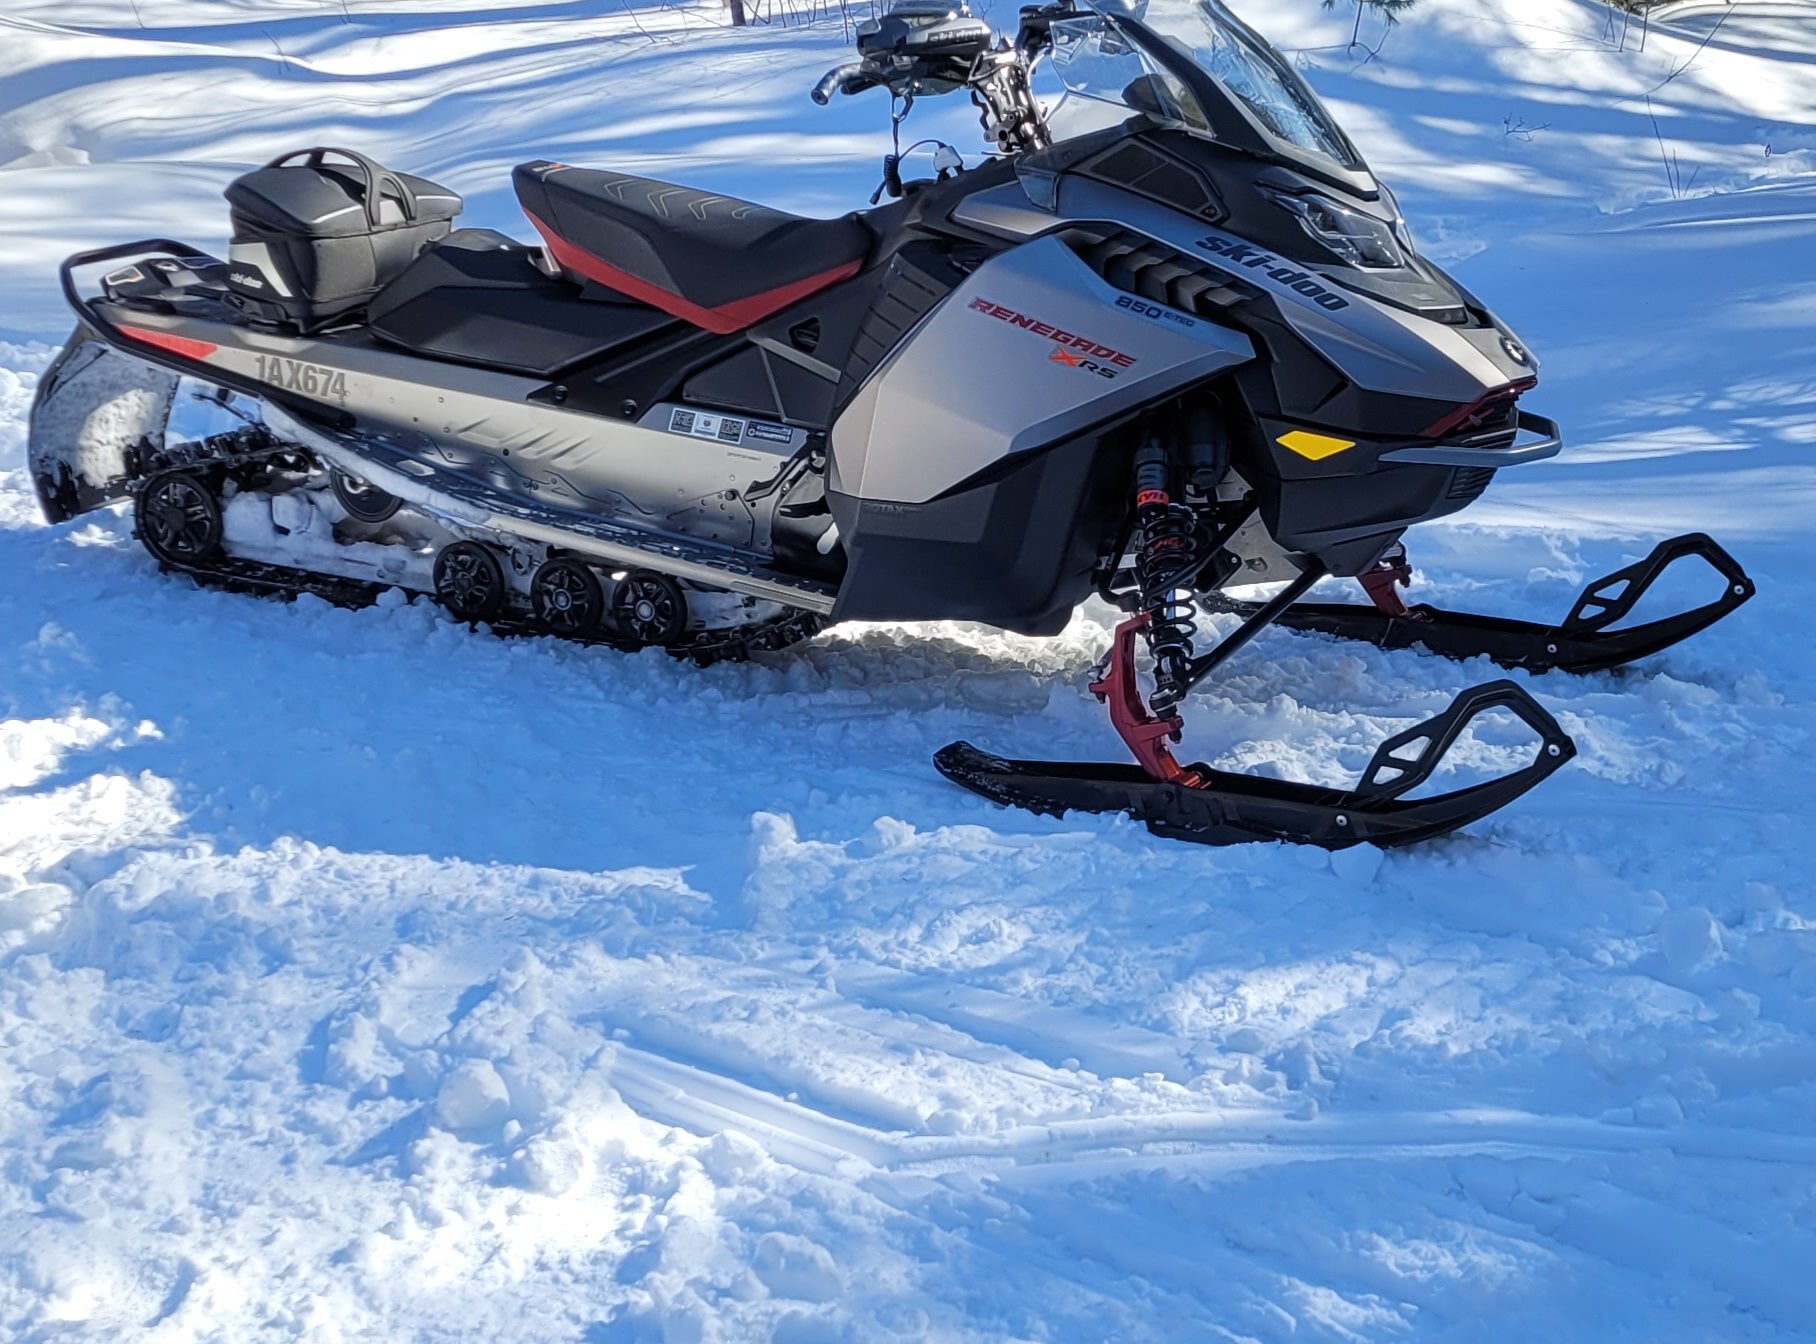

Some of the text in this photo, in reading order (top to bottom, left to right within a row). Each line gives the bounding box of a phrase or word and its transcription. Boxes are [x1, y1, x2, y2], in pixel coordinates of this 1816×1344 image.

[968, 296, 1137, 368] RENEGADE
[1115, 295, 1162, 320] 850
[255, 355, 351, 407] 1AX674
